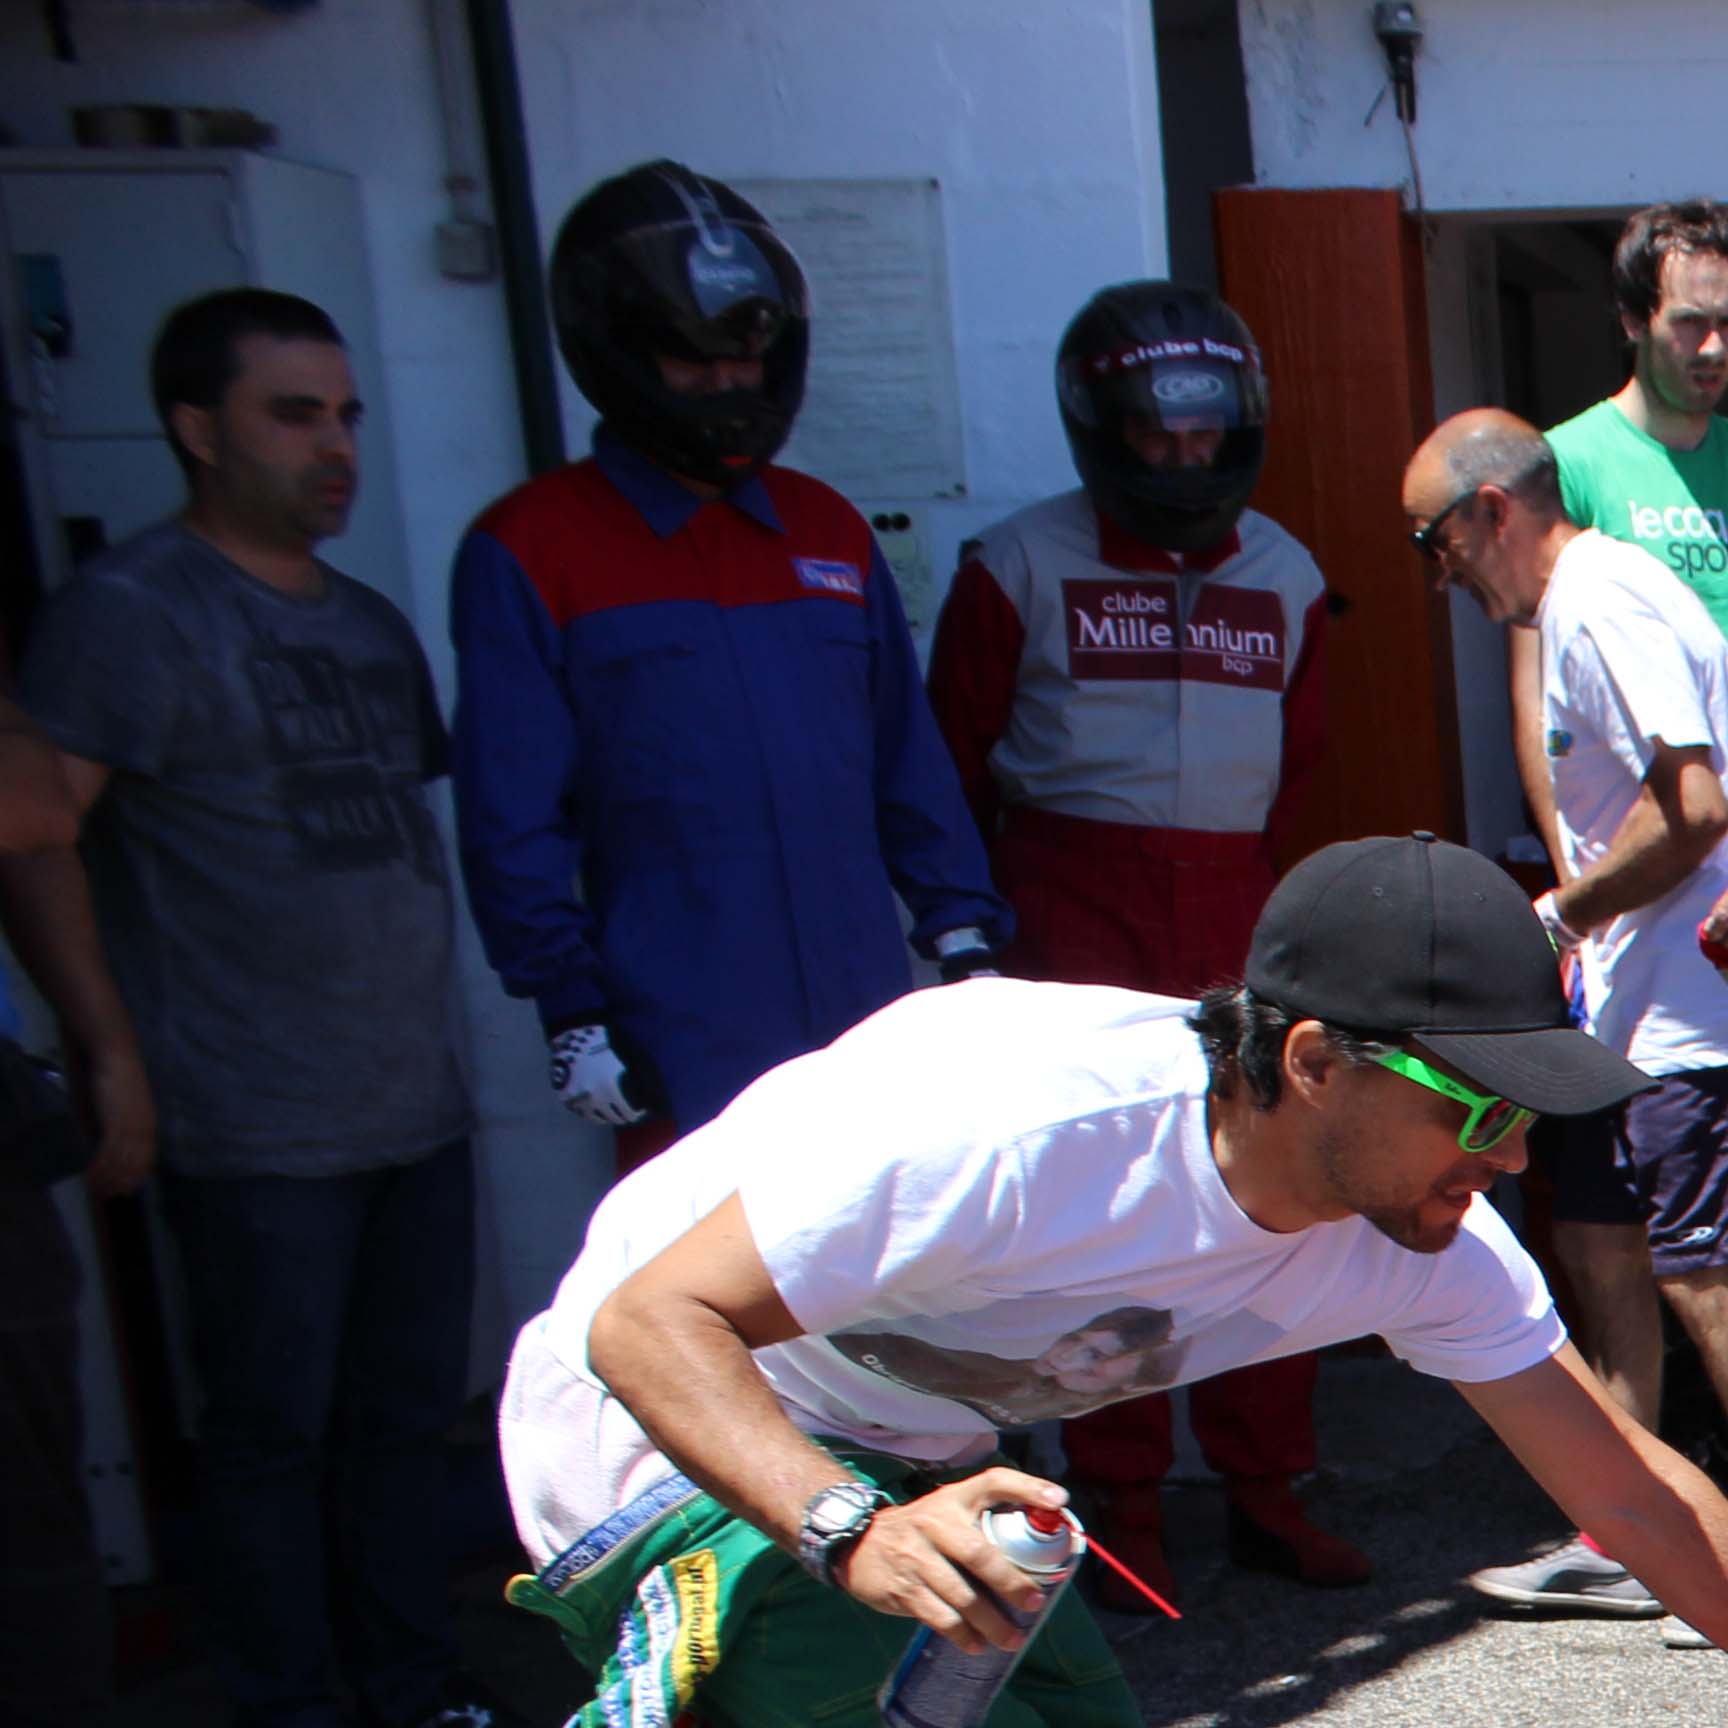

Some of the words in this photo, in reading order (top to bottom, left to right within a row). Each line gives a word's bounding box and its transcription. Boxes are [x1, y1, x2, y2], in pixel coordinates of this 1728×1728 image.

[1120, 339, 1200, 368] clube
[1202, 337, 1245, 362] bcp
[1102, 591, 1167, 614] clube
[1074, 608, 1277, 656] Millennium
[1222, 653, 1254, 677] bcp
